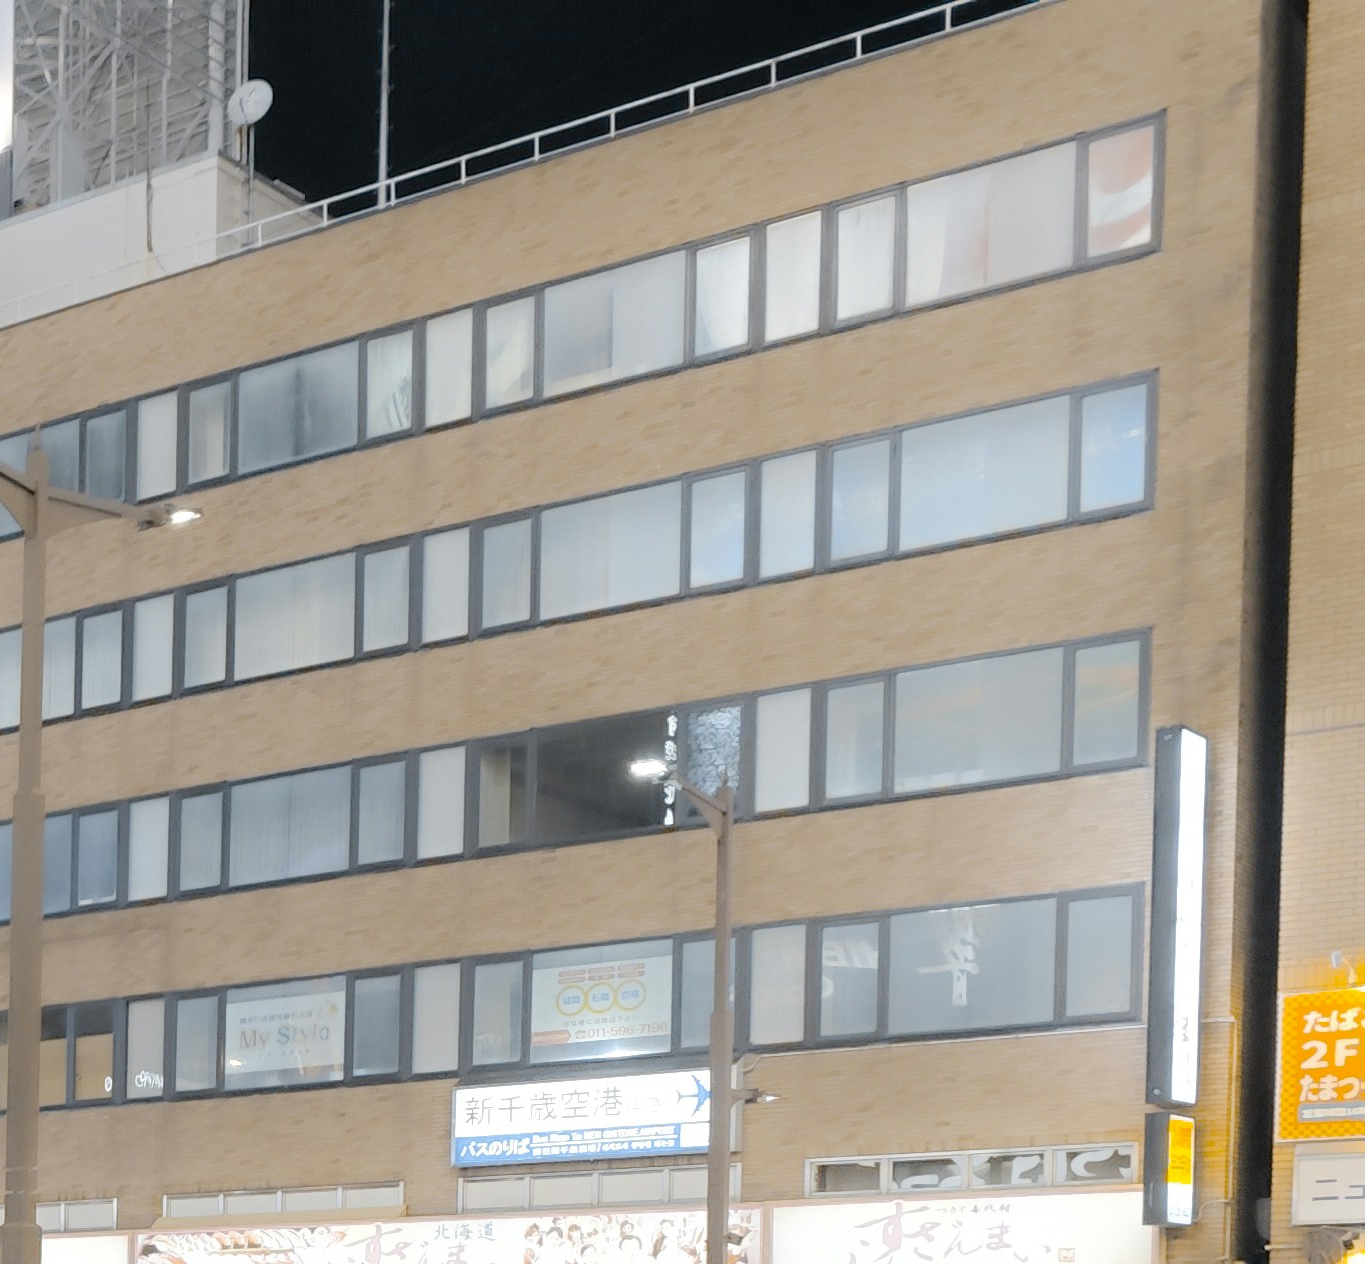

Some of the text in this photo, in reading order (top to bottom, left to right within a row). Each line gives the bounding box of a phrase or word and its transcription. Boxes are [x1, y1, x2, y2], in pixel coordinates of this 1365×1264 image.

[1299, 1074, 1365, 1102] たまつ
[461, 1137, 531, 1158] バスのりば
[434, 1221, 497, 1240] 北海道
